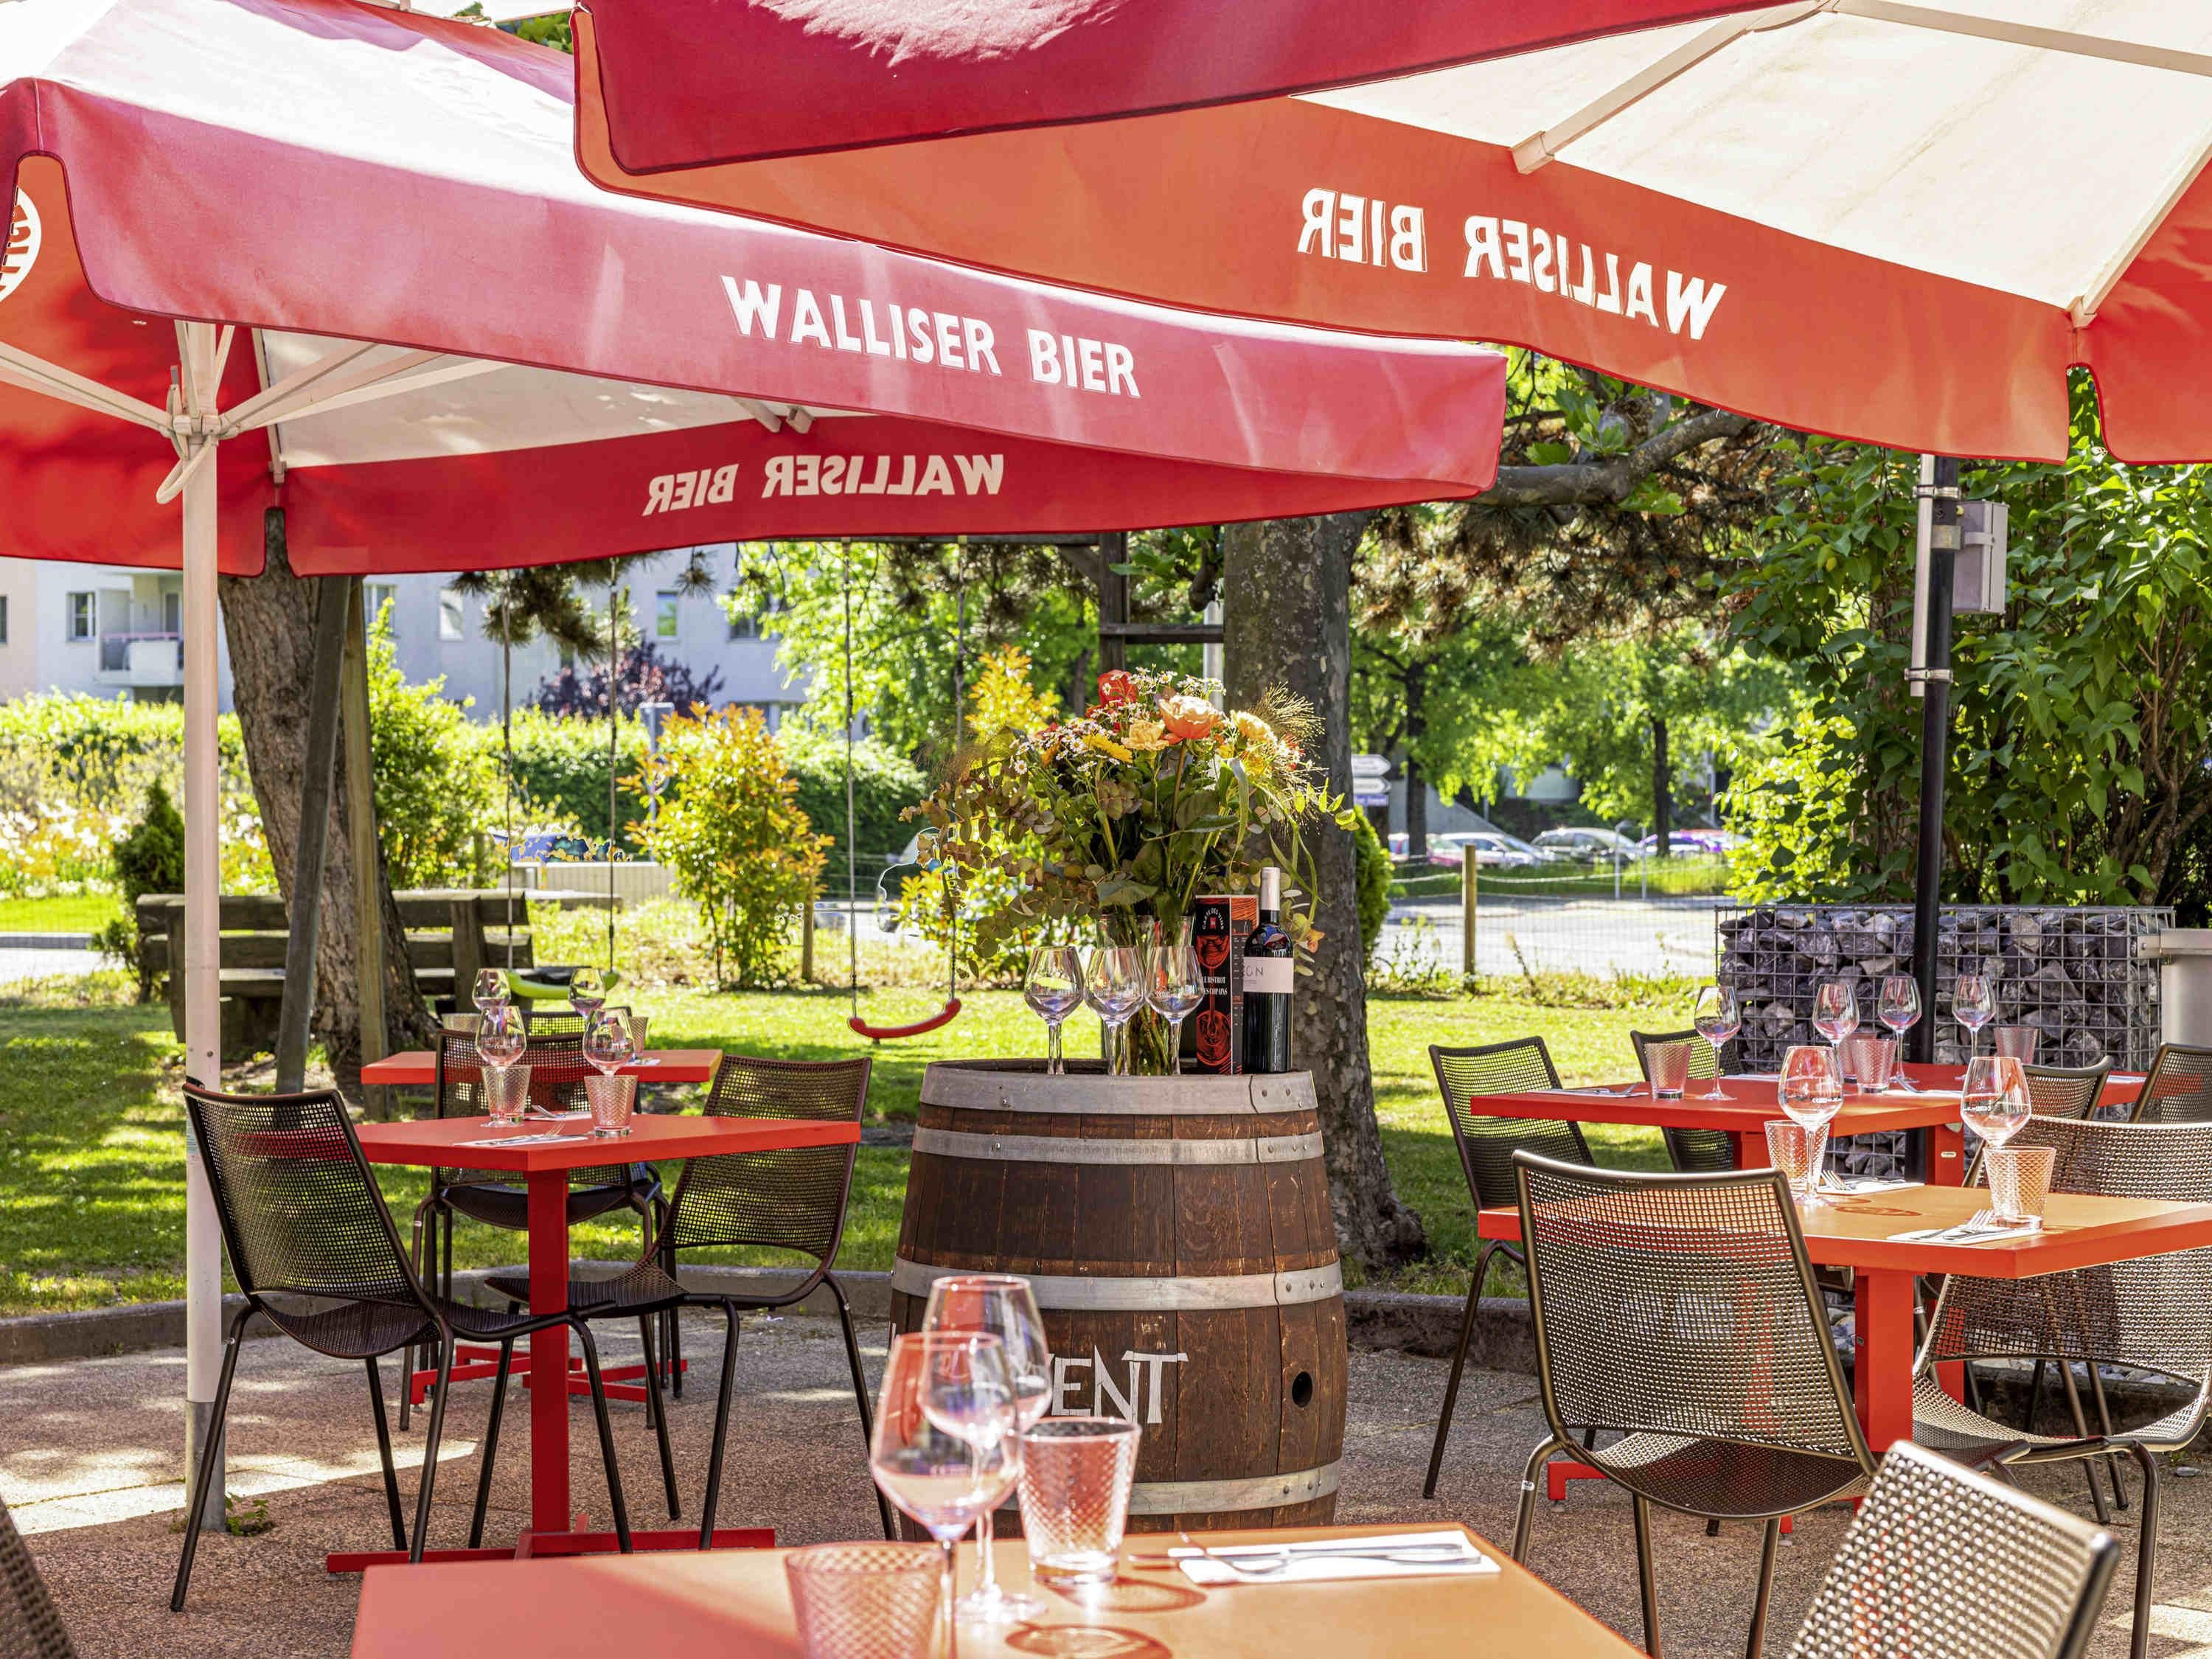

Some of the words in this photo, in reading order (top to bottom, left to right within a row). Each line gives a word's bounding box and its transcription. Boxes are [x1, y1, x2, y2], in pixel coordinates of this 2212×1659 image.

[720, 275, 1001, 375] WALLISER
[1028, 328, 1141, 398] BIER
[1048, 1344, 1189, 1424] ENT
